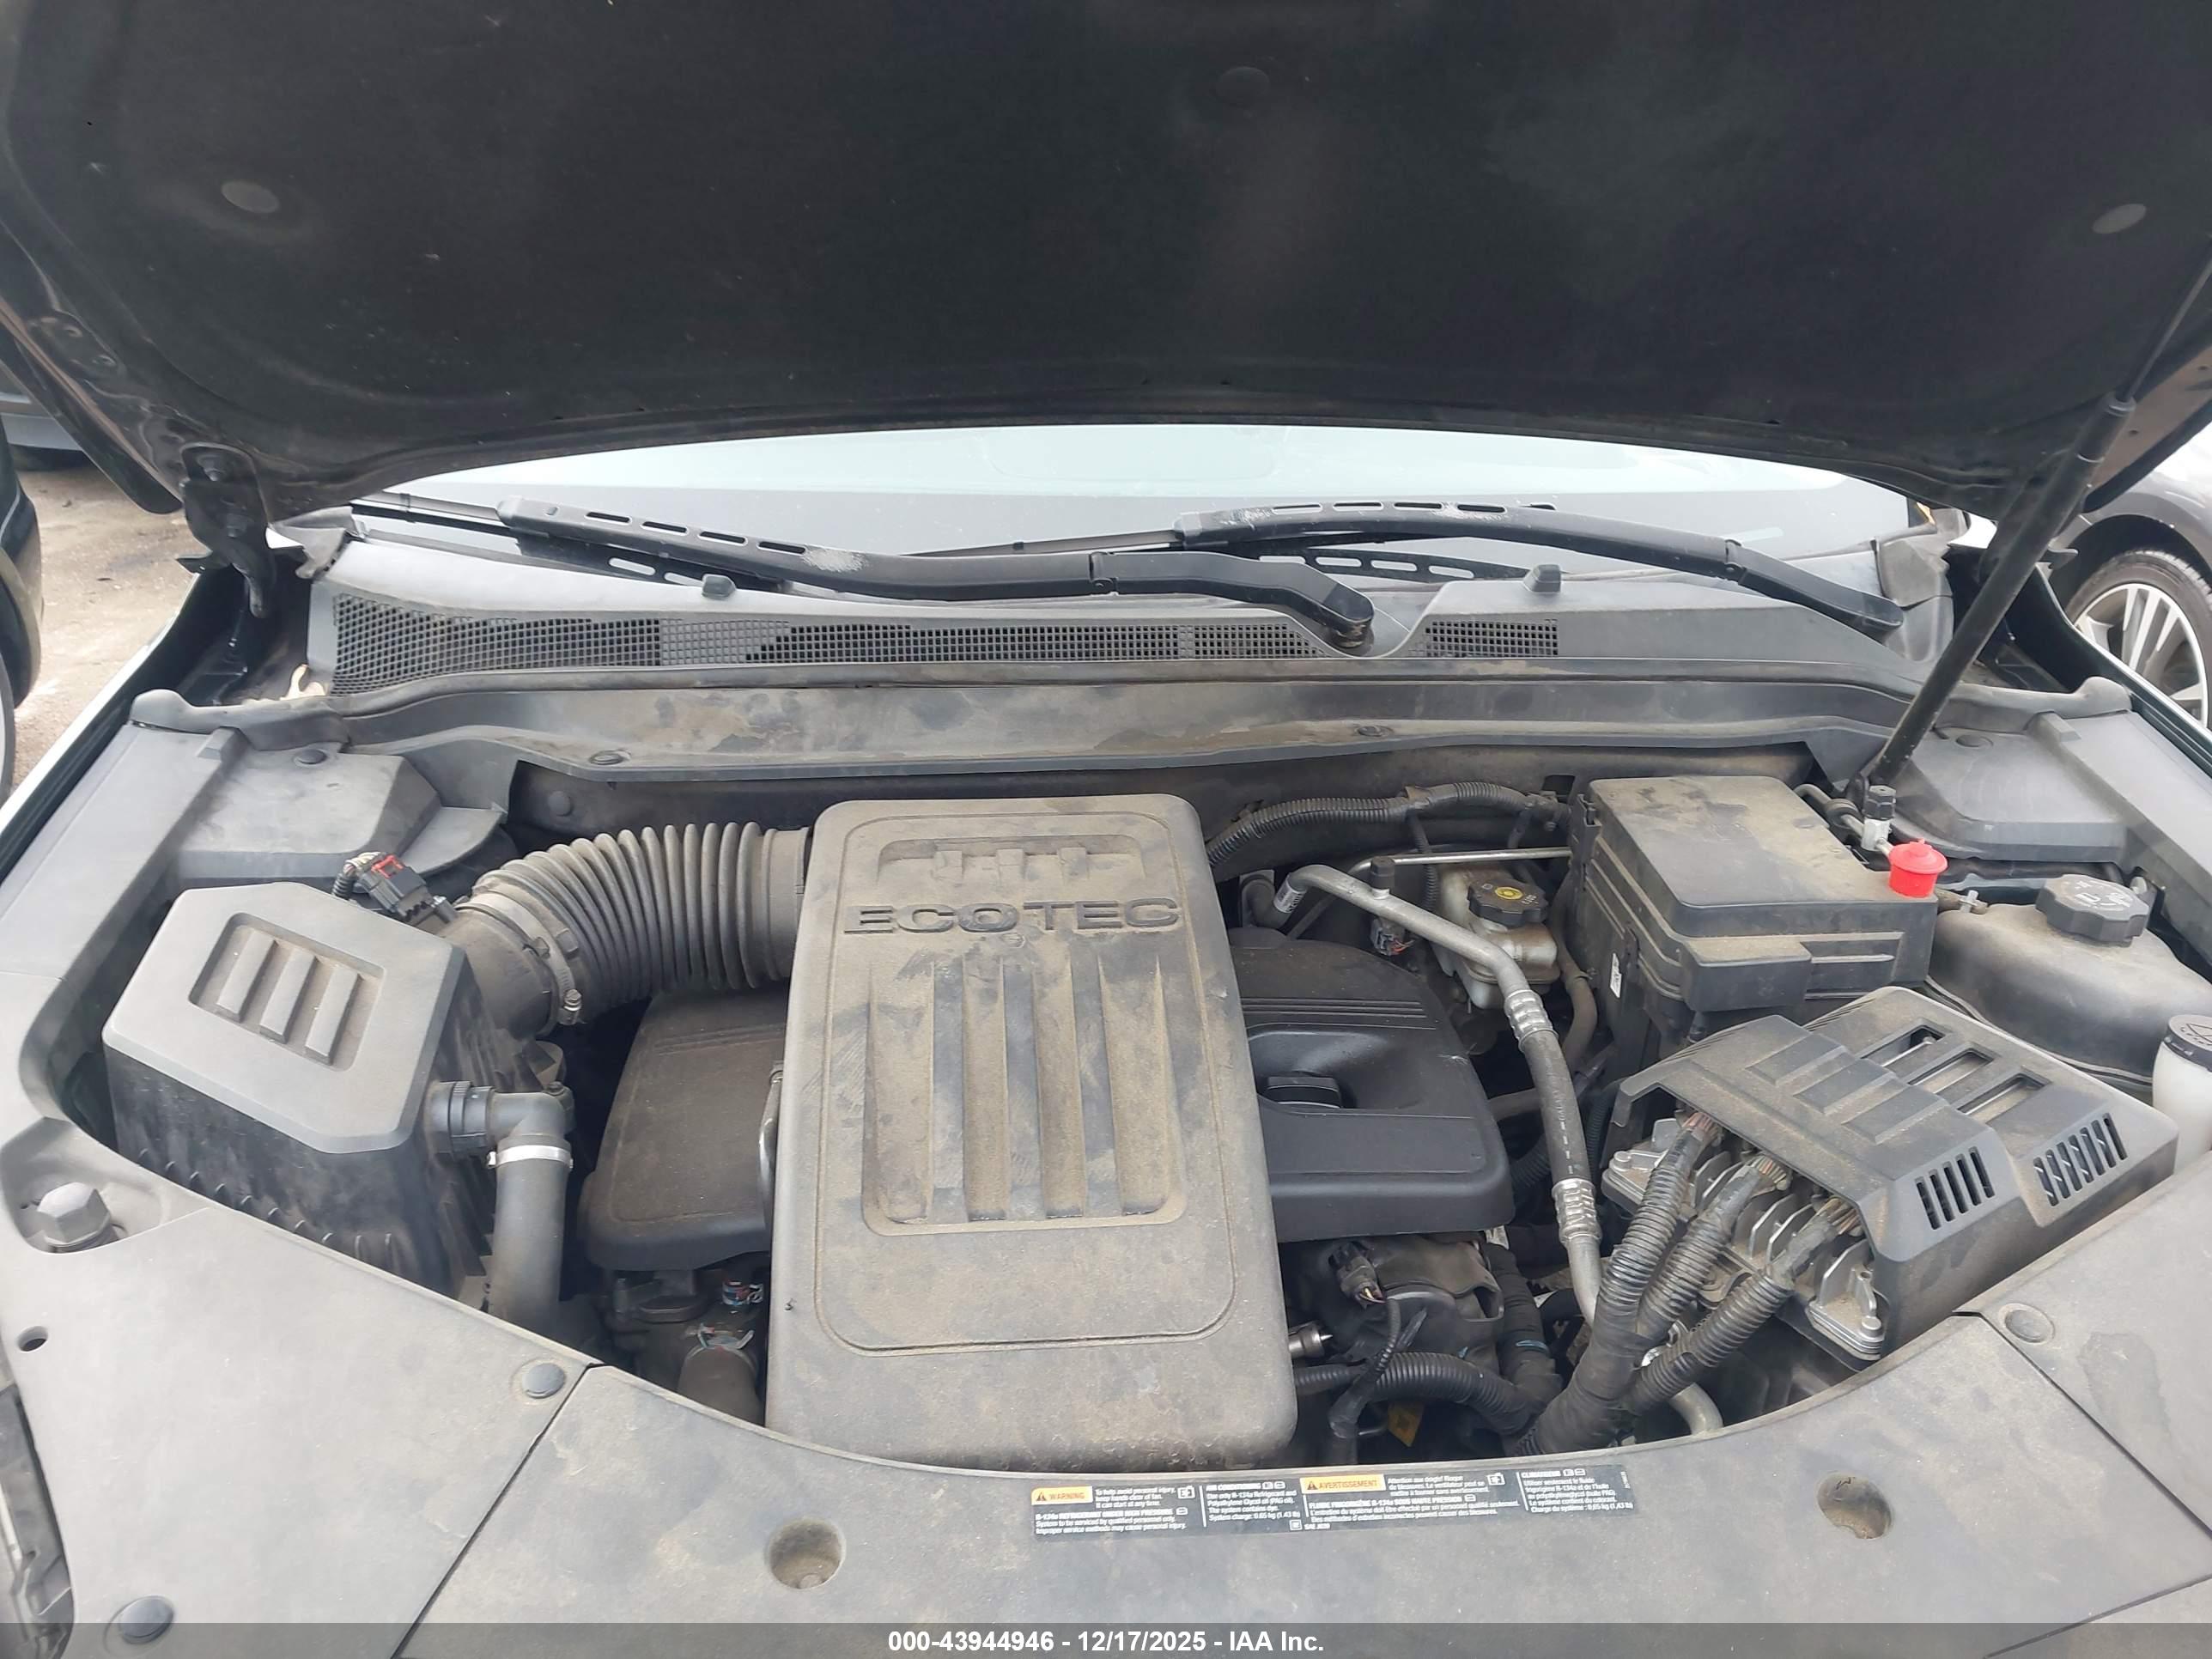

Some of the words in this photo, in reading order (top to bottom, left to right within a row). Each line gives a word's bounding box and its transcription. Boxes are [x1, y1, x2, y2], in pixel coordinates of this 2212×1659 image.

[844, 897, 1179, 933] ECOTEC
[1318, 1480, 1376, 1489] AVERTISSEMENT
[1048, 1492, 1085, 1500] WARNING
